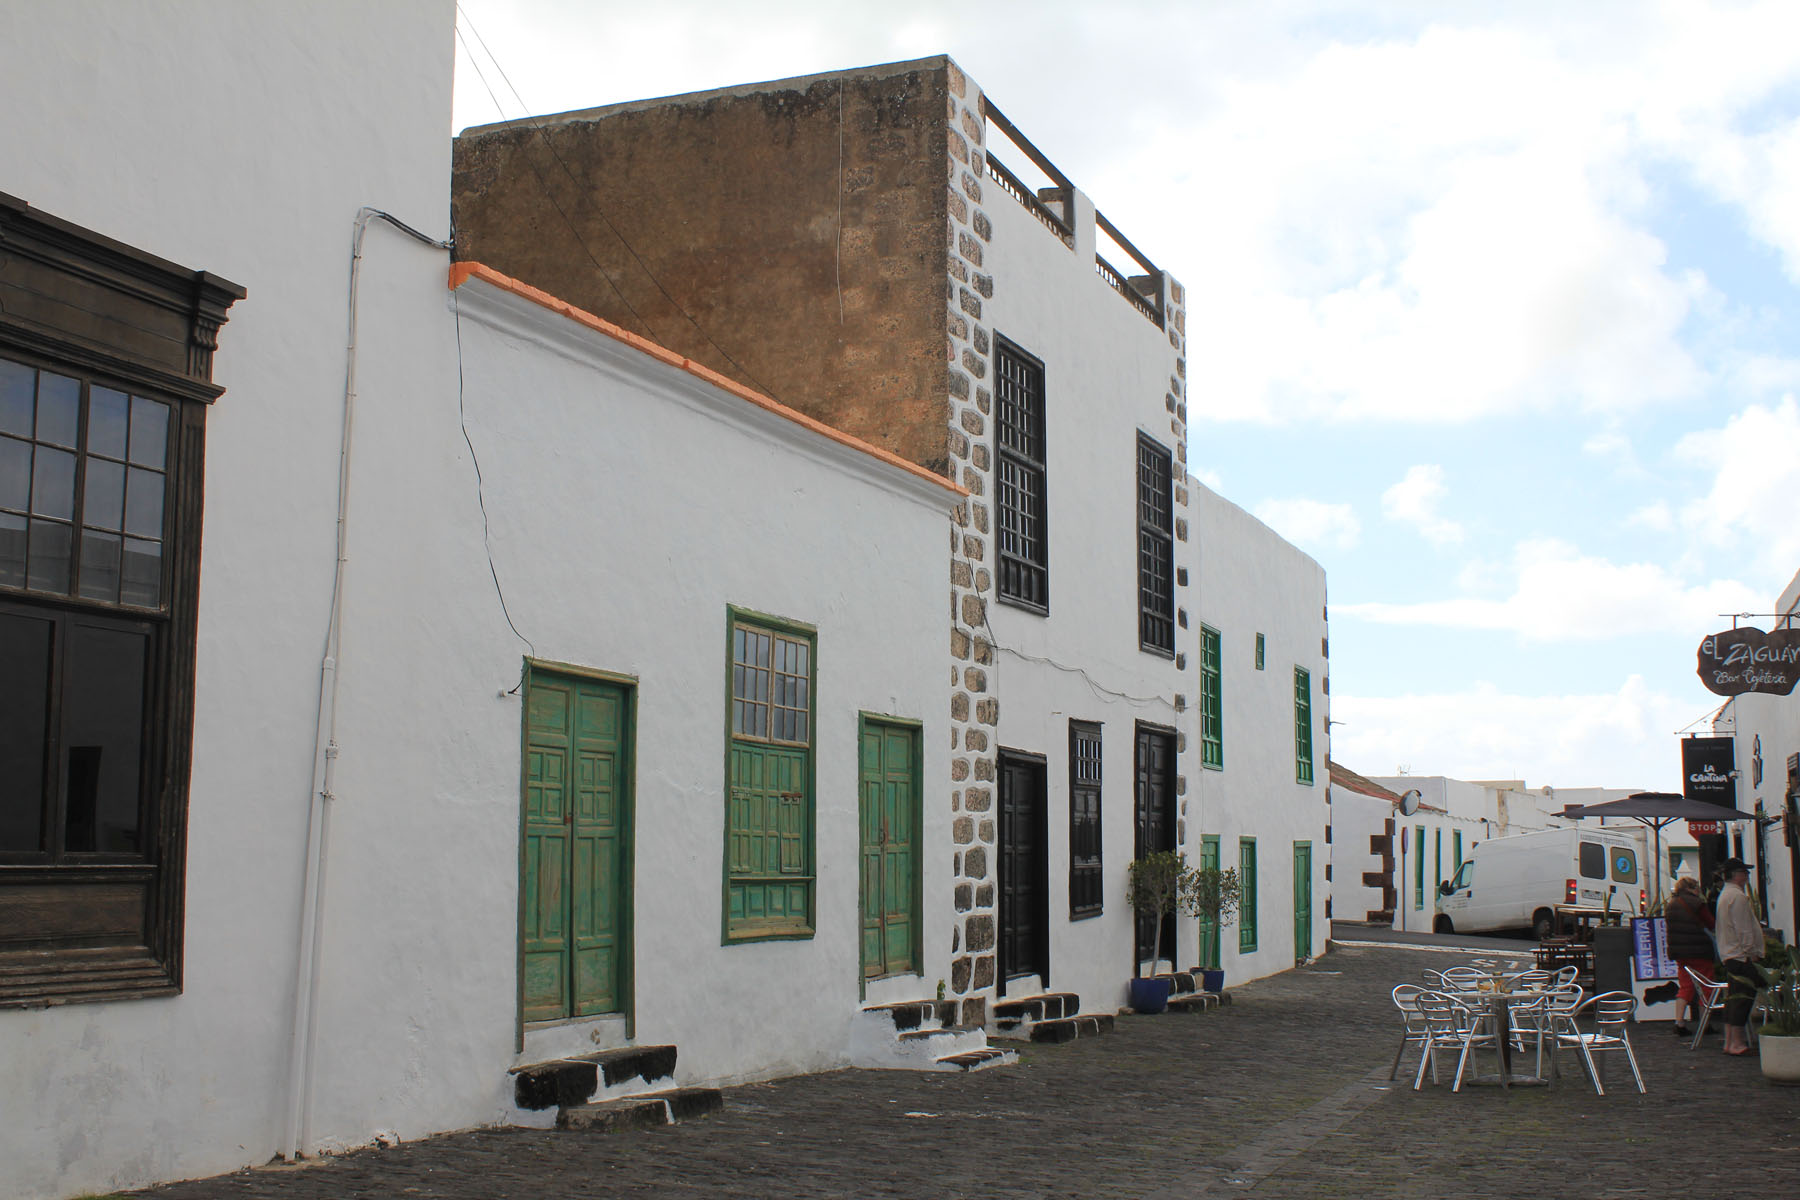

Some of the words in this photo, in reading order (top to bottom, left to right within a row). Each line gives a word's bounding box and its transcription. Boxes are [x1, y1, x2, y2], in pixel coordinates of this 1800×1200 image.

[1713, 670, 1740, 684] Bar
[1703, 764, 1715, 773] LA
[1690, 823, 1716, 831] STOP
